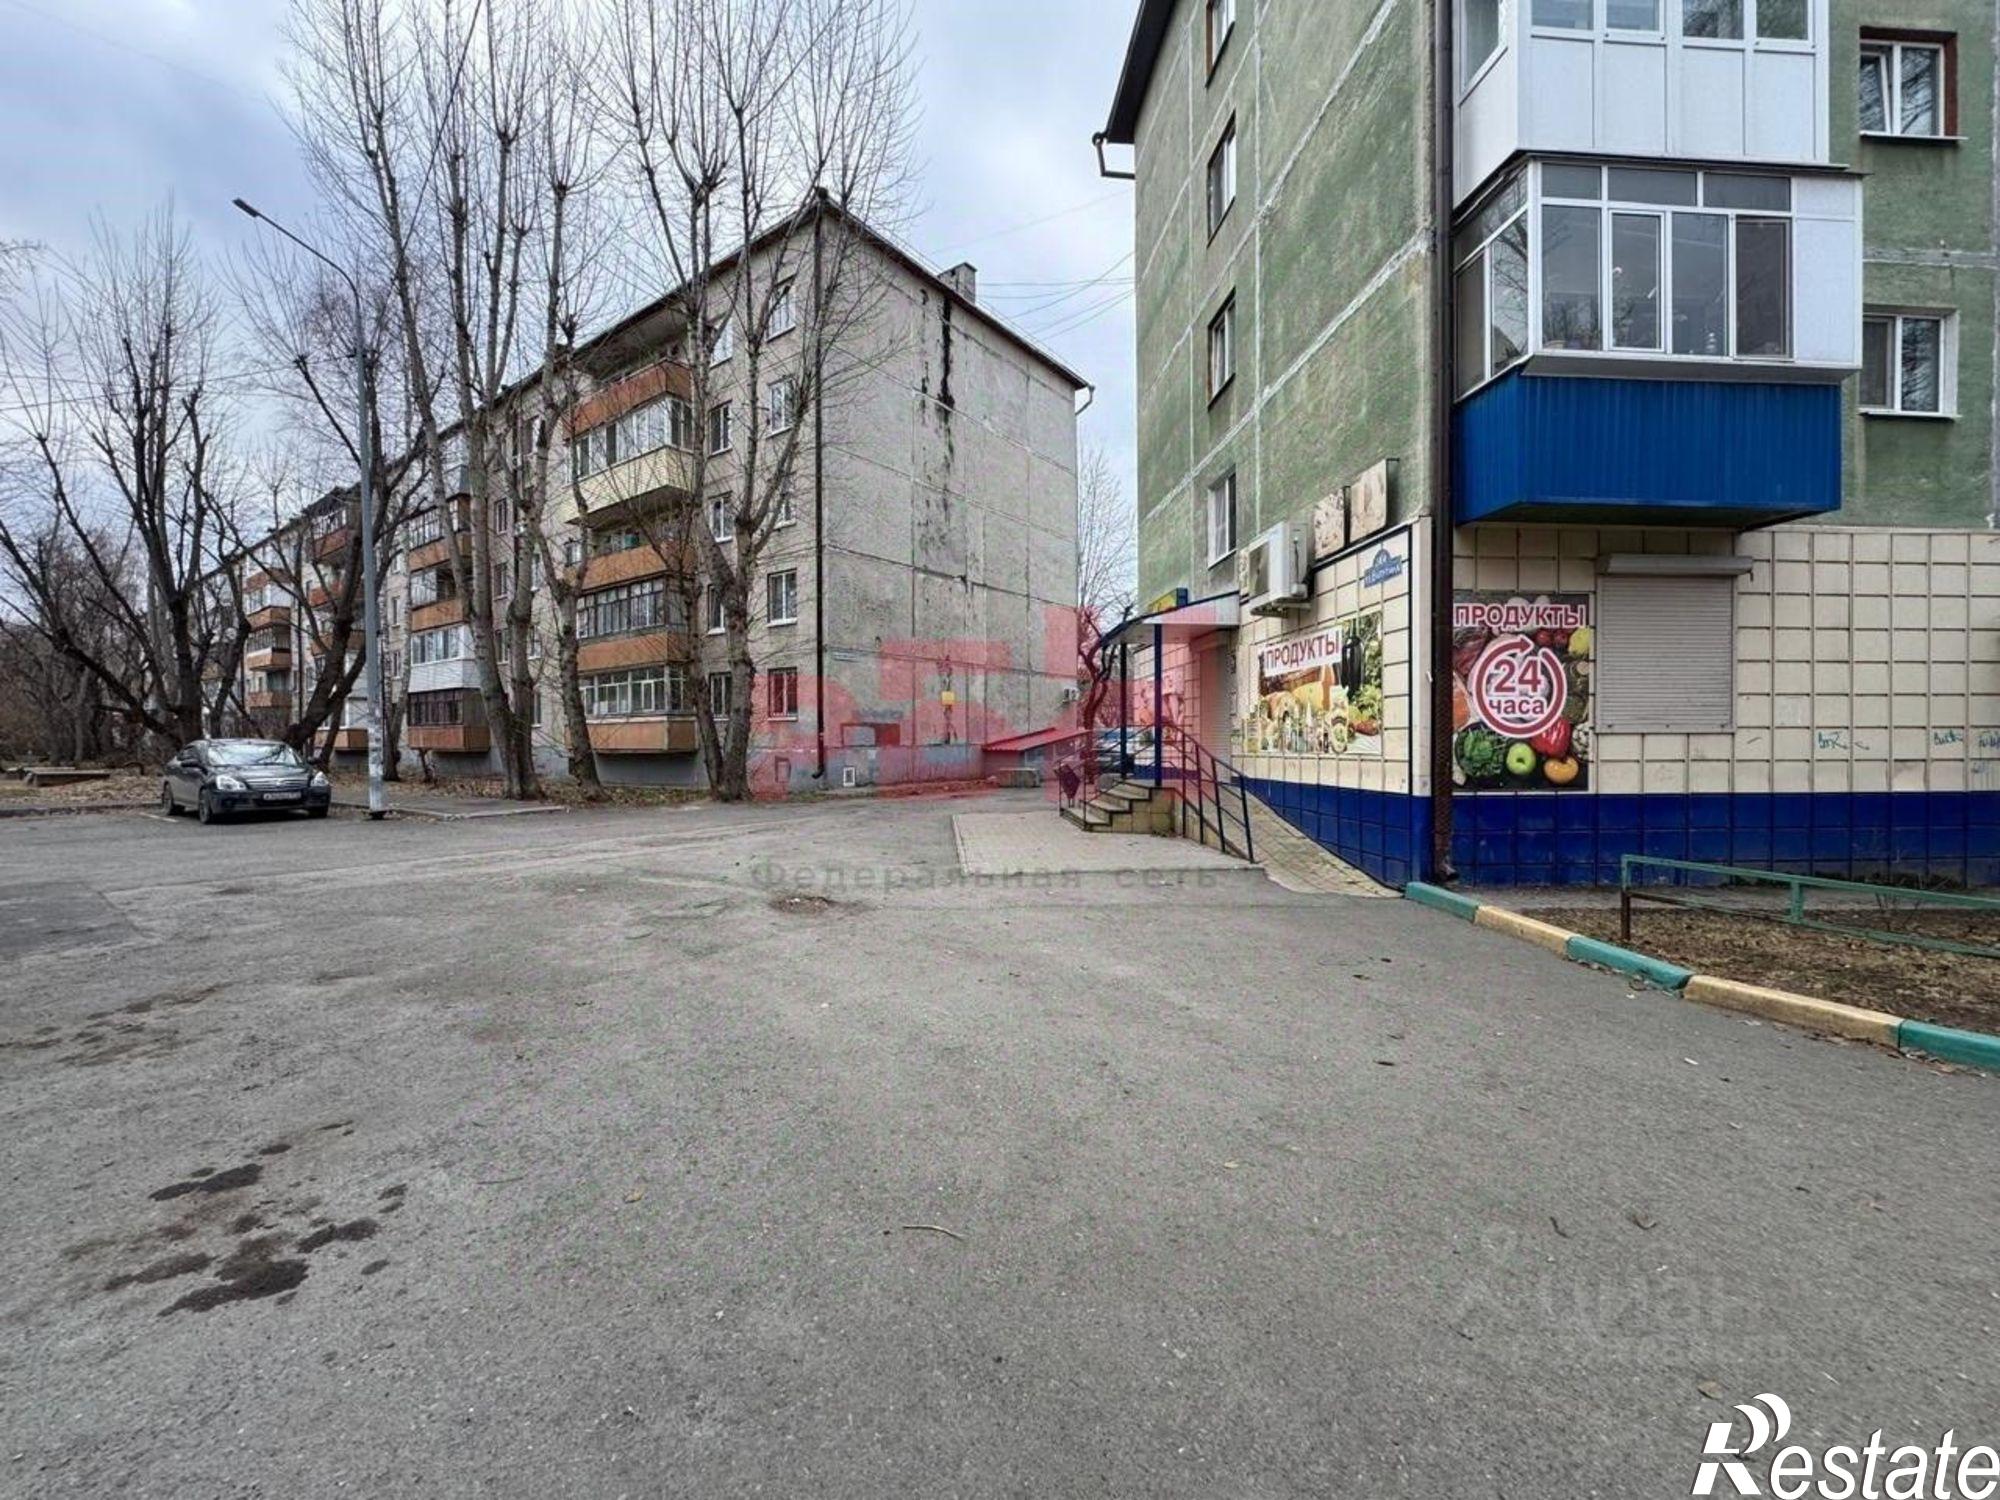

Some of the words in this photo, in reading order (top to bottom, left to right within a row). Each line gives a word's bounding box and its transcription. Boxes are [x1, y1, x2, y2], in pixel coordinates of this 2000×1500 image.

[1454, 604, 1586, 631] ПРОДУКТЫ
[1265, 630, 1340, 669] ПРОДУКТЫ
[1493, 658, 1541, 693] 24
[1488, 698, 1545, 715] часа
